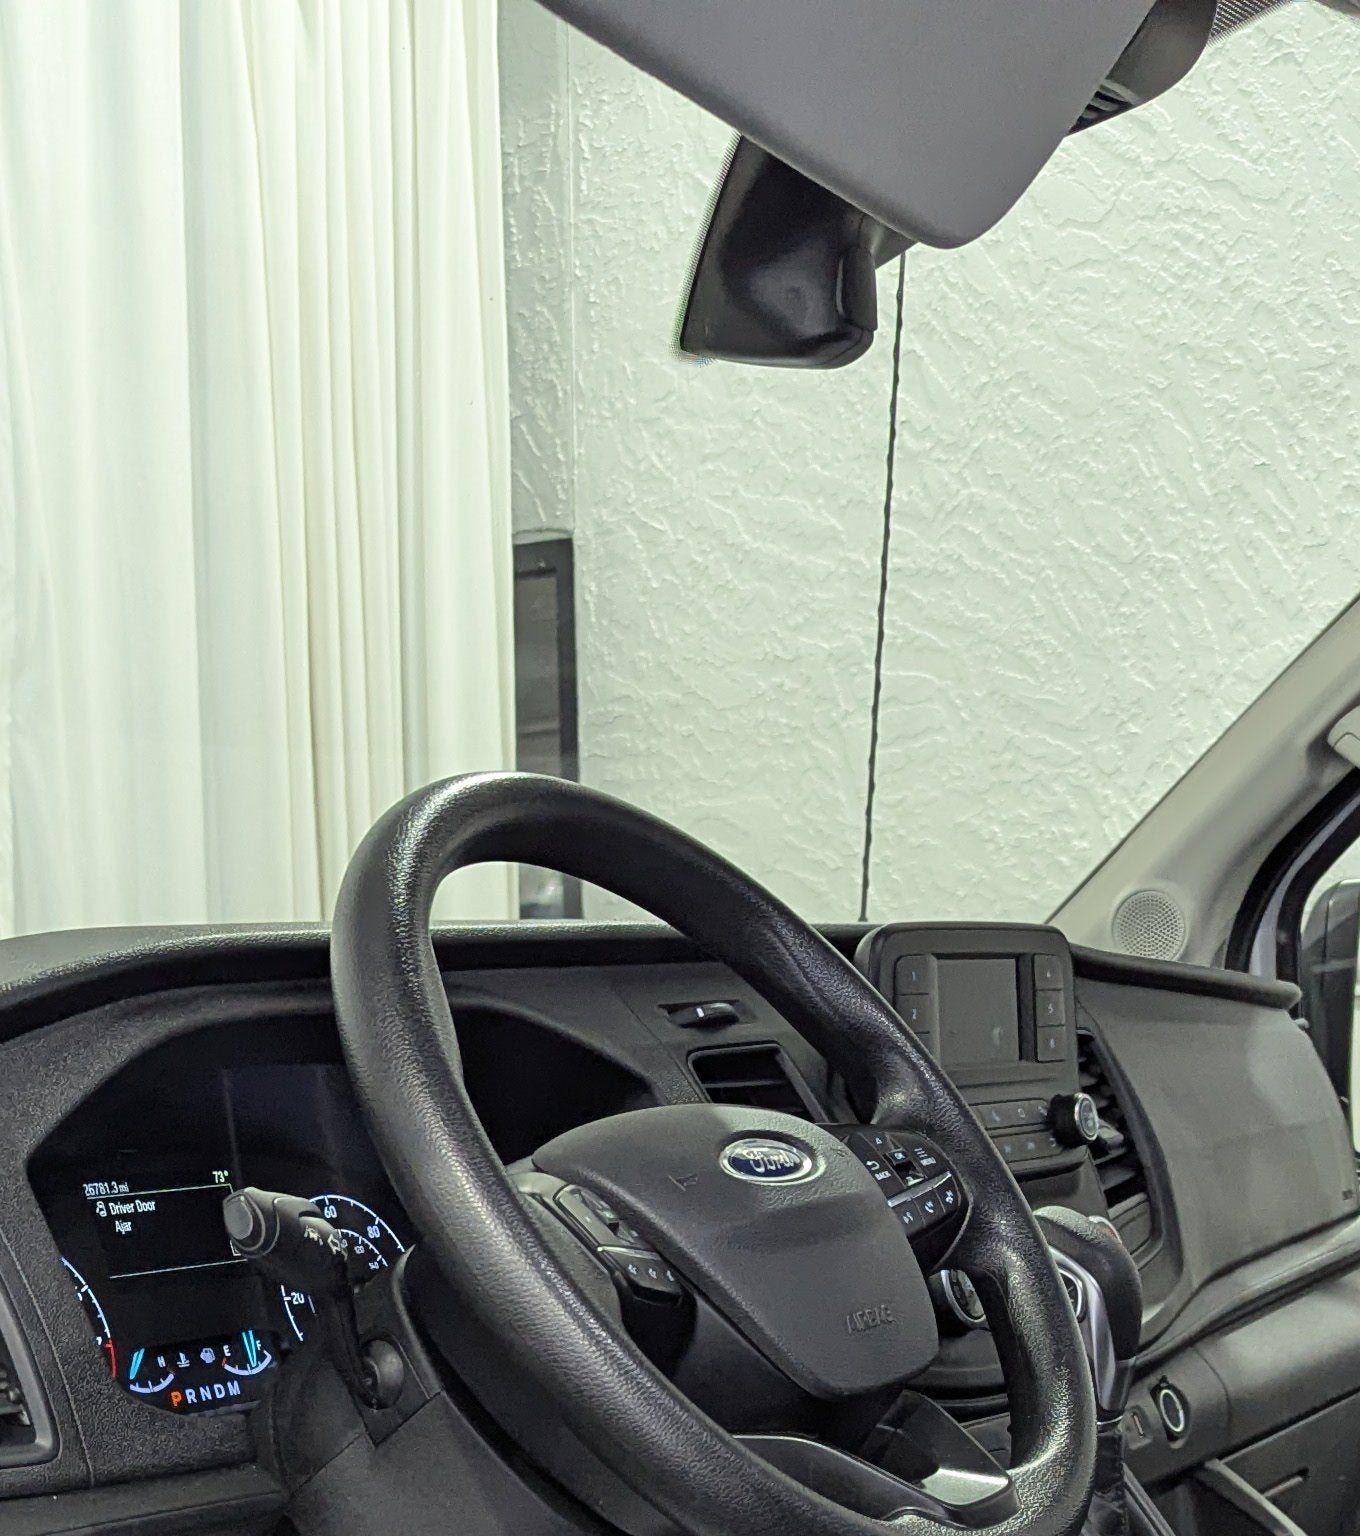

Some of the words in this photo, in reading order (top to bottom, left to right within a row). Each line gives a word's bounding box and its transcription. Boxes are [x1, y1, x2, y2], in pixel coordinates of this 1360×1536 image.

[83, 1181, 118, 1197] 26781.3
[109, 1202, 135, 1216] Driver
[135, 1199, 156, 1214] Door
[324, 1205, 338, 1219] 60
[115, 1220, 132, 1235] Ajar
[367, 1225, 381, 1239] 80
[223, 1345, 232, 1357] E
[256, 1340, 263, 1351] F
[157, 1356, 167, 1368] H
